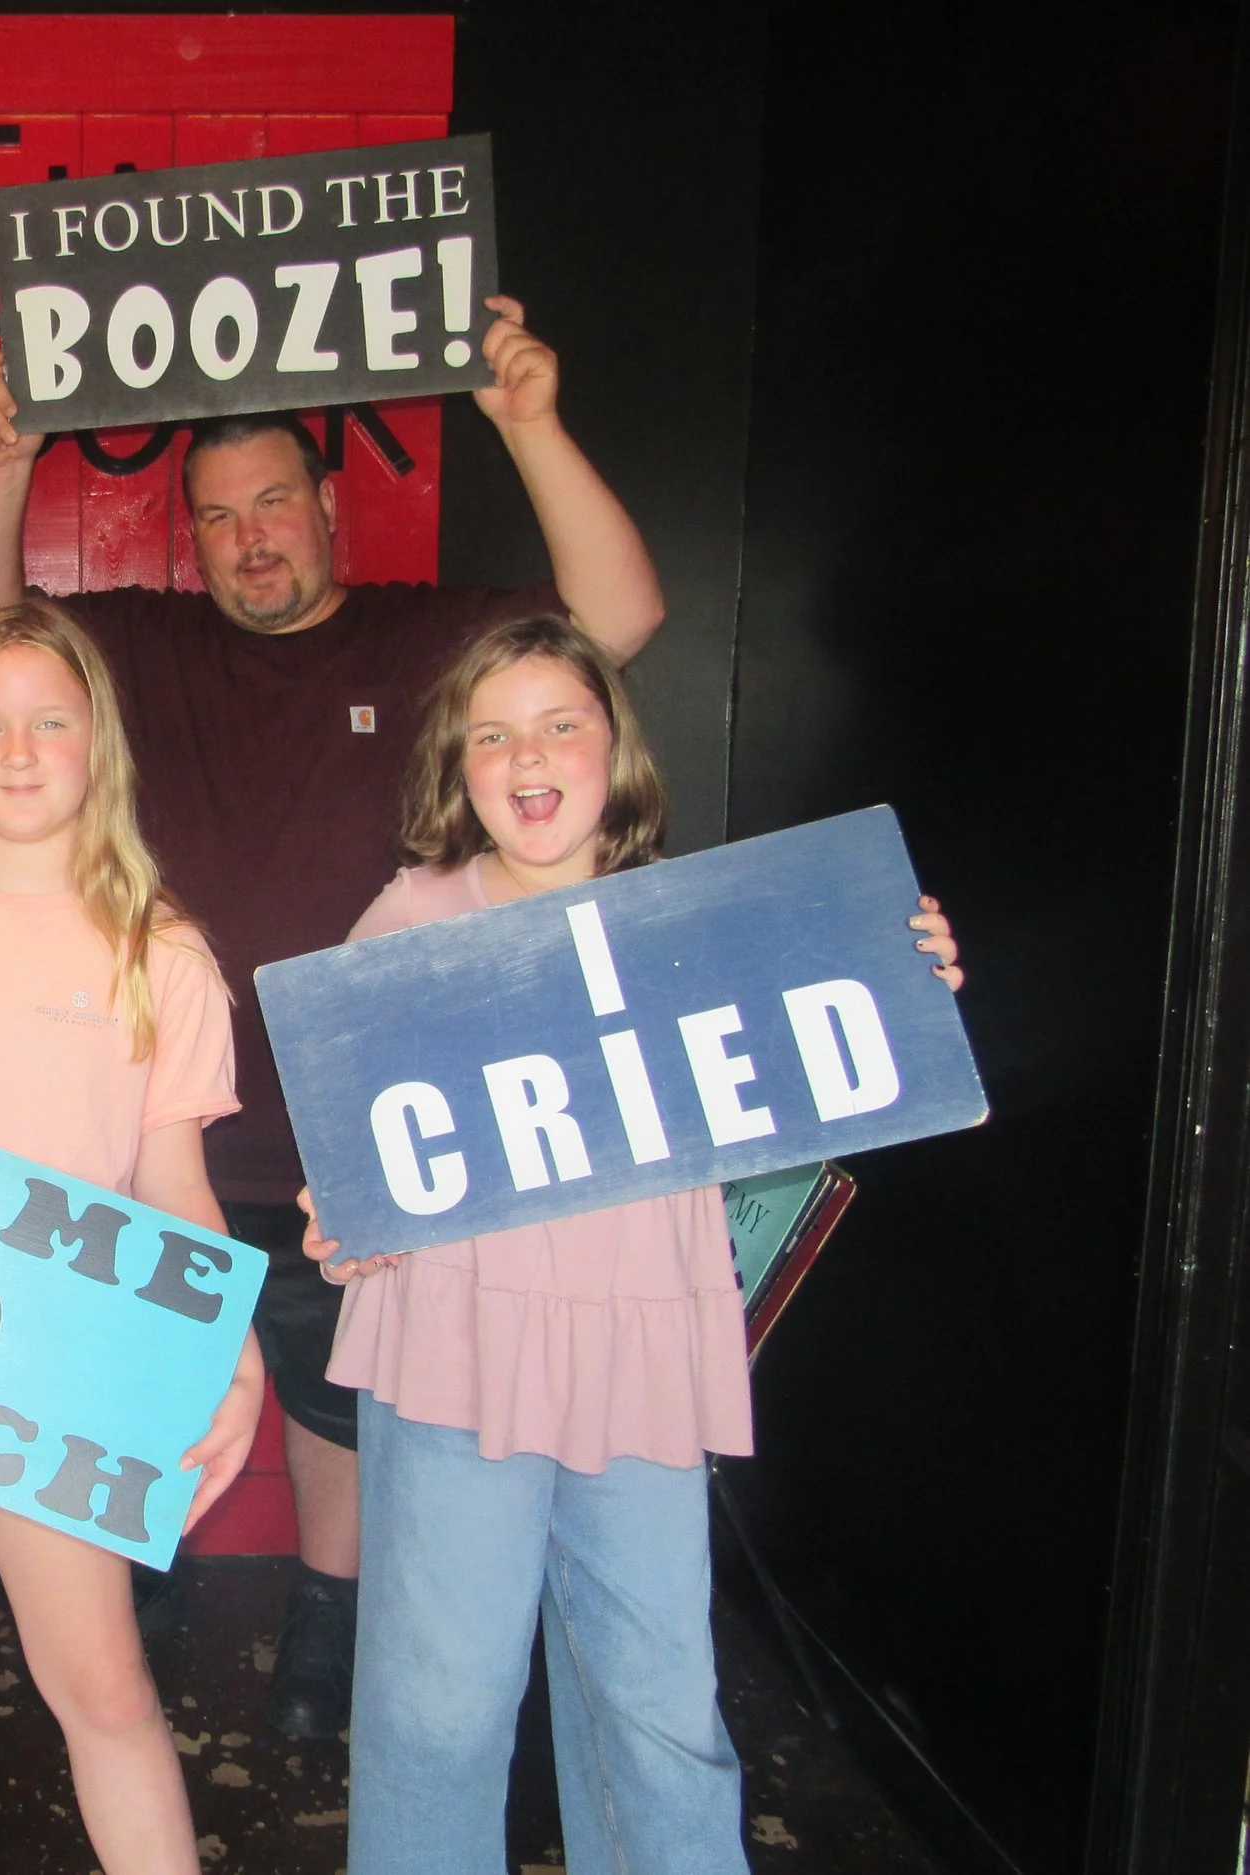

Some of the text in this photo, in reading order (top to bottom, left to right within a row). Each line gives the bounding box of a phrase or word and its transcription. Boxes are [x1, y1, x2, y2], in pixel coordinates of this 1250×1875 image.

[11, 165, 471, 262] I FOUND THE
[14, 235, 473, 403] BOOZE!
[564, 900, 627, 1018] I
[369, 978, 901, 1217] CRIED
[729, 1190, 771, 1235] MY
